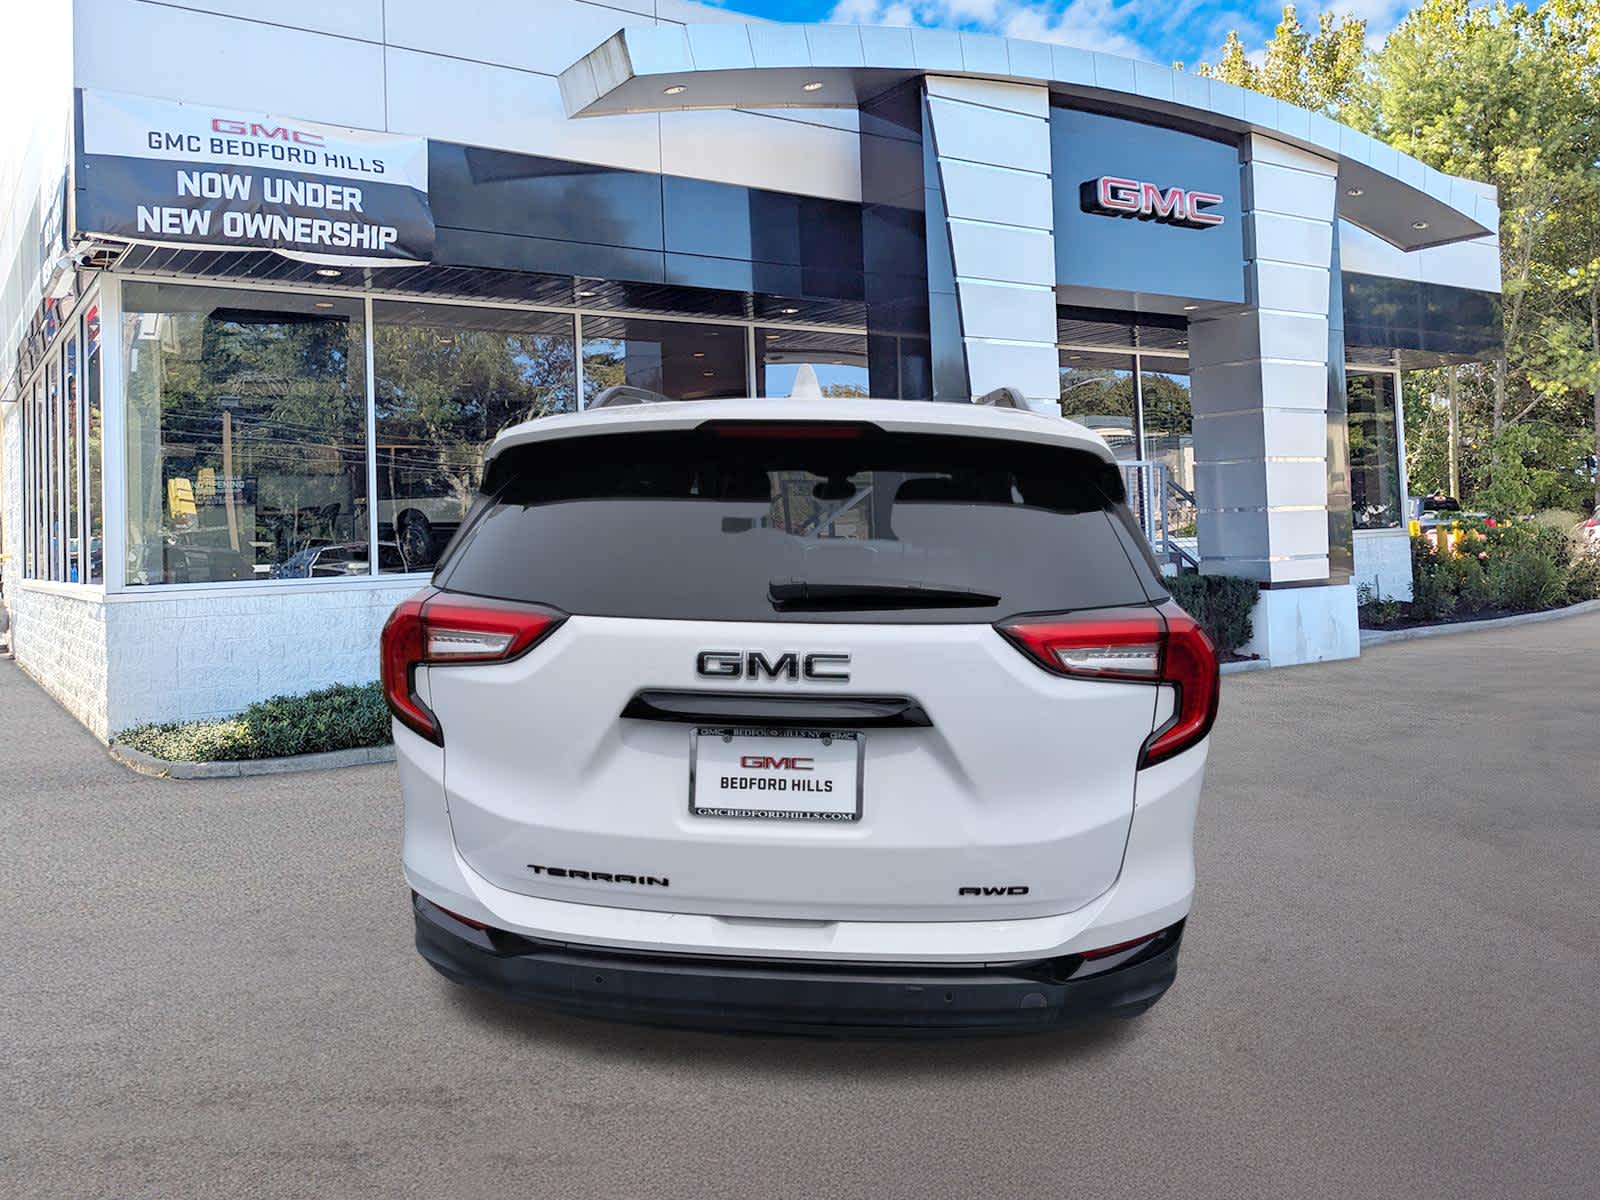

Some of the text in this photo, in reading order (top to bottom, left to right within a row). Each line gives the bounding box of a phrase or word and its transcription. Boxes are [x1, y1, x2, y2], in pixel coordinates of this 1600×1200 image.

[211, 117, 325, 148] GMC
[148, 131, 385, 174] GMC BEDFORD HILLS
[177, 170, 364, 213] NOW UNDER
[1096, 175, 1225, 225] GMC
[136, 205, 398, 250] NEW OWNERSHIP
[697, 650, 850, 681] GMC
[700, 727, 725, 737] GMC
[740, 755, 814, 771] GMC
[720, 776, 833, 793] BEDFORD HILLS
[697, 807, 853, 821] GMCBEDFORDHILLS.COM
[527, 864, 669, 887] TERRAIN
[958, 886, 1029, 896] AWD
